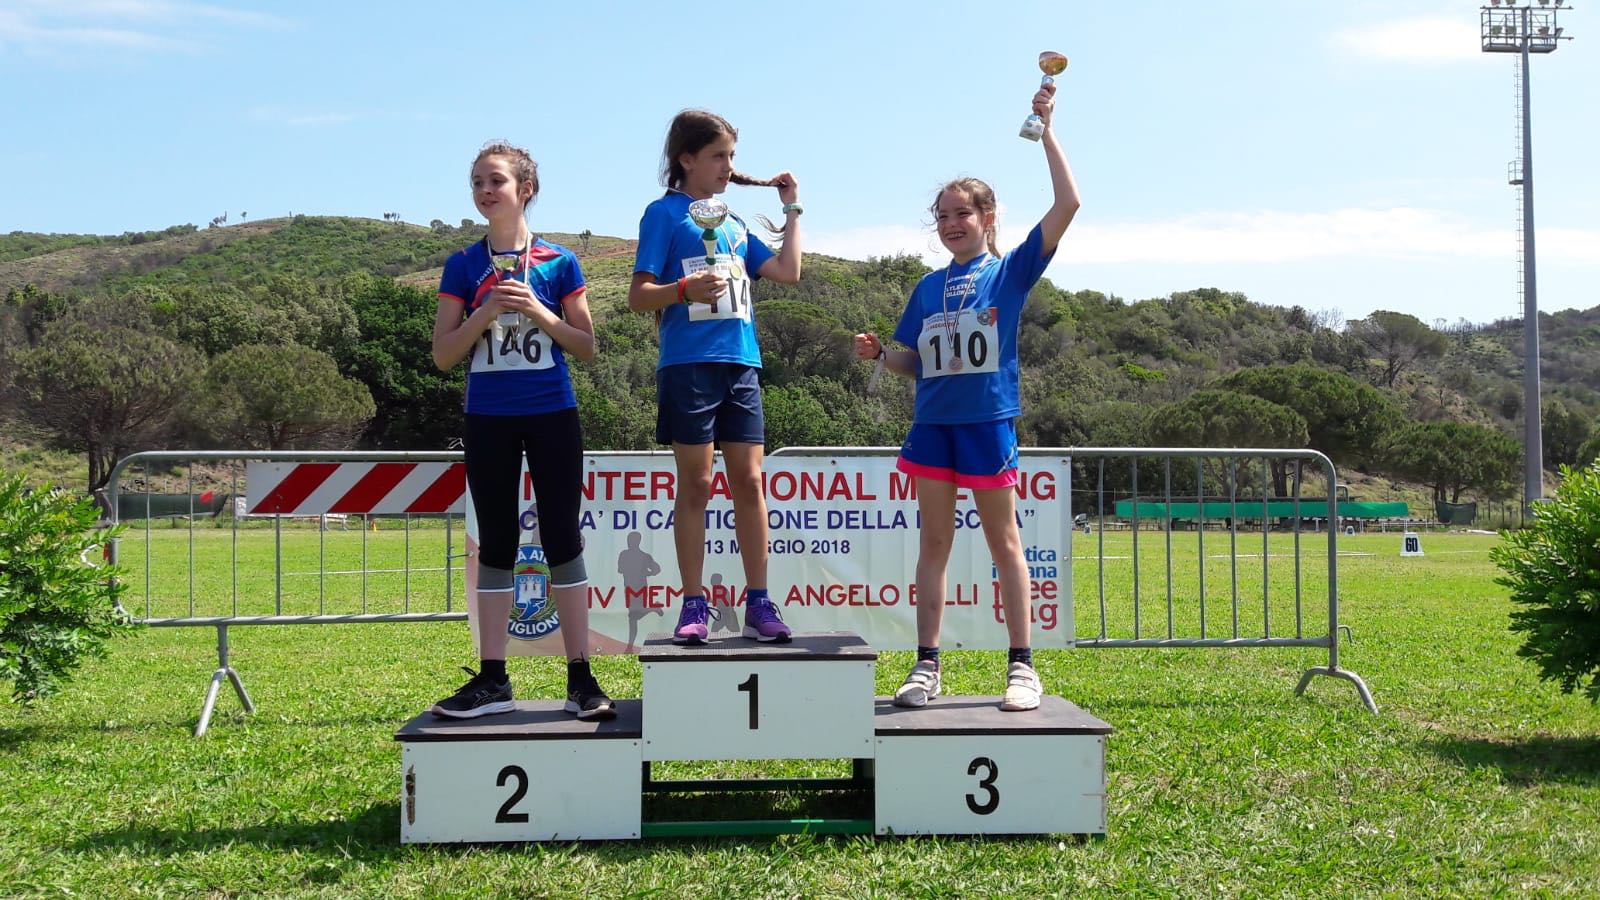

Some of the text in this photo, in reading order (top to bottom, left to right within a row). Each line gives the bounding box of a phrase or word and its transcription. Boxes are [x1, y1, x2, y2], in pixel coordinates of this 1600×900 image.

[711, 277, 748, 314] 14
[482, 328, 541, 365] 146
[929, 331, 987, 371] 110
[613, 511, 637, 530] DI
[827, 510, 908, 530] DELLA
[705, 540, 723, 554] 13
[811, 540, 850, 554] 2018
[1405, 537, 1418, 552] 60
[784, 584, 900, 607] ANGELO
[737, 674, 760, 730] 1
[495, 765, 530, 823] 2
[966, 757, 1000, 815] 3
